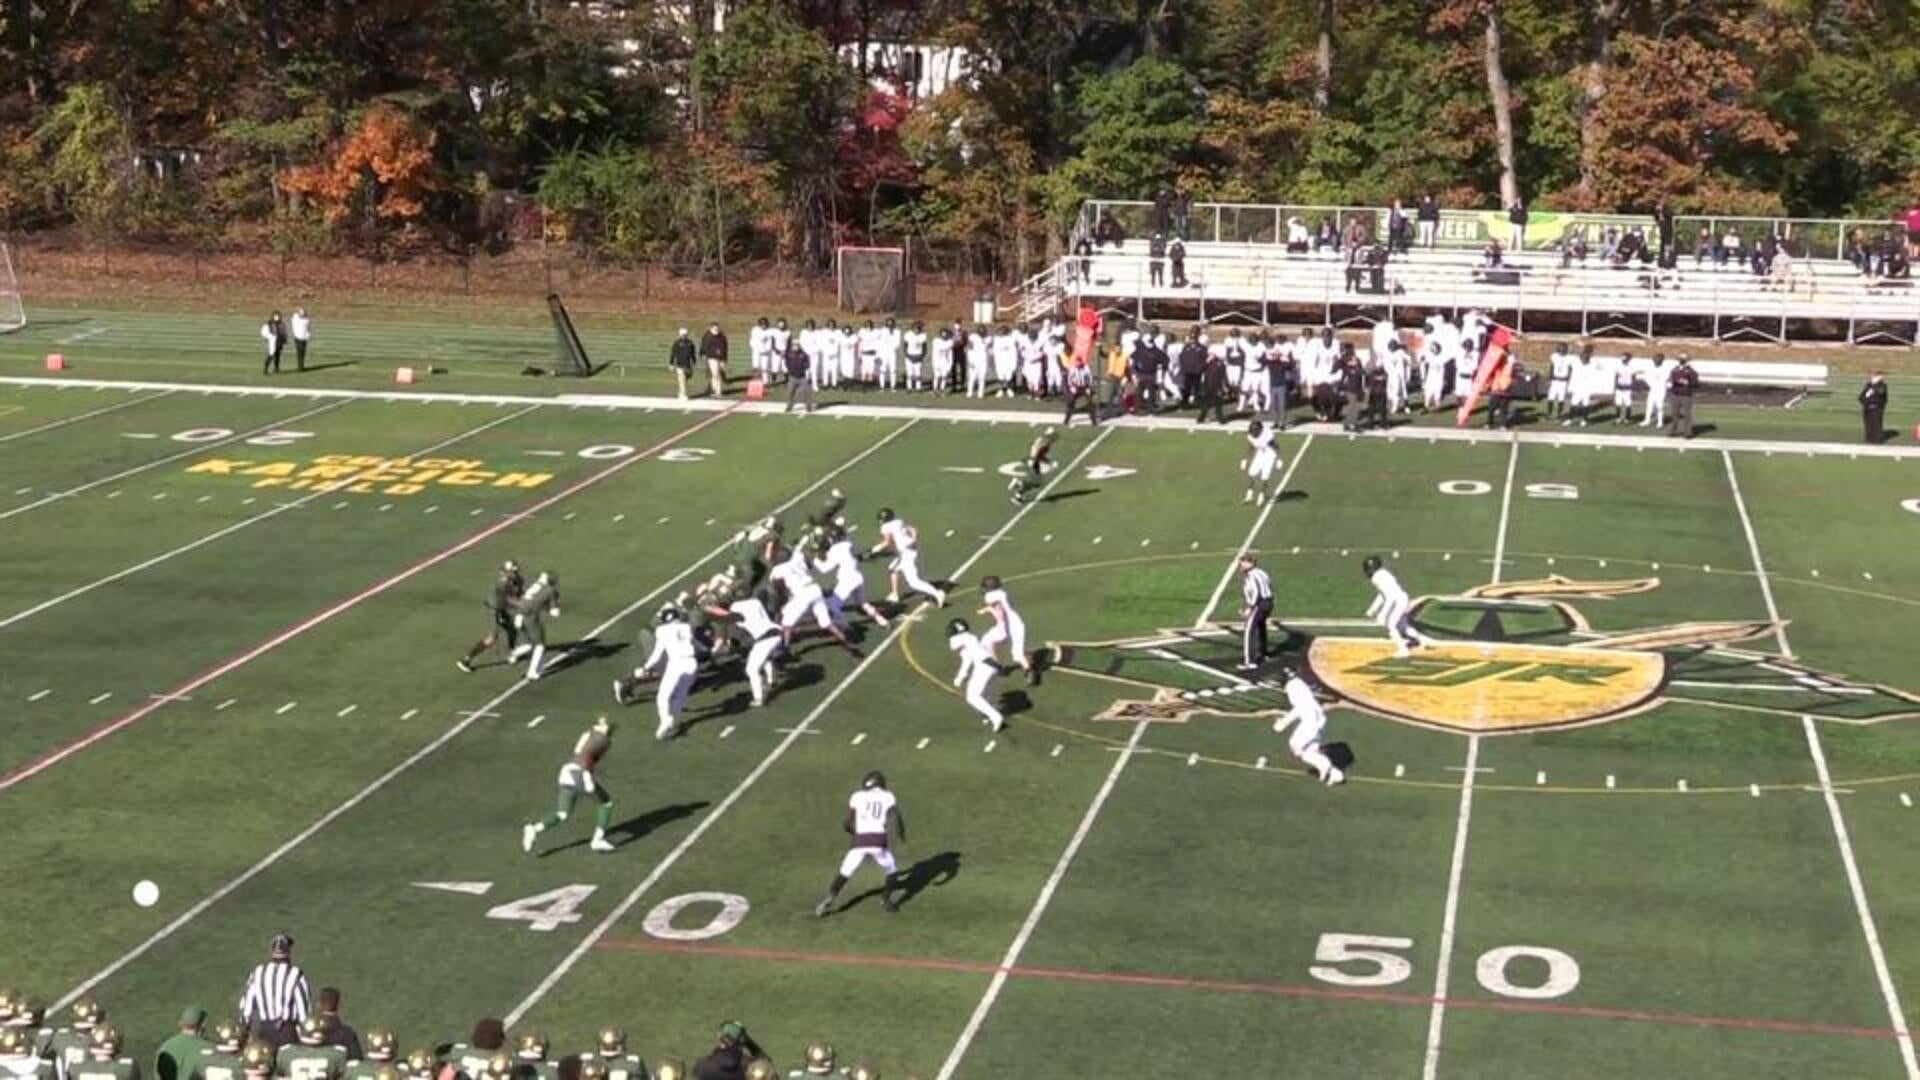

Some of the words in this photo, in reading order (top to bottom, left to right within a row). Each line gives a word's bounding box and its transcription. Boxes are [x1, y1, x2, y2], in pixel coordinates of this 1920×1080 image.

[251, 477, 426, 495] FIELD
[1438, 480, 1579, 499] 50
[484, 884, 750, 940] 40
[1308, 932, 1580, 999] 50
